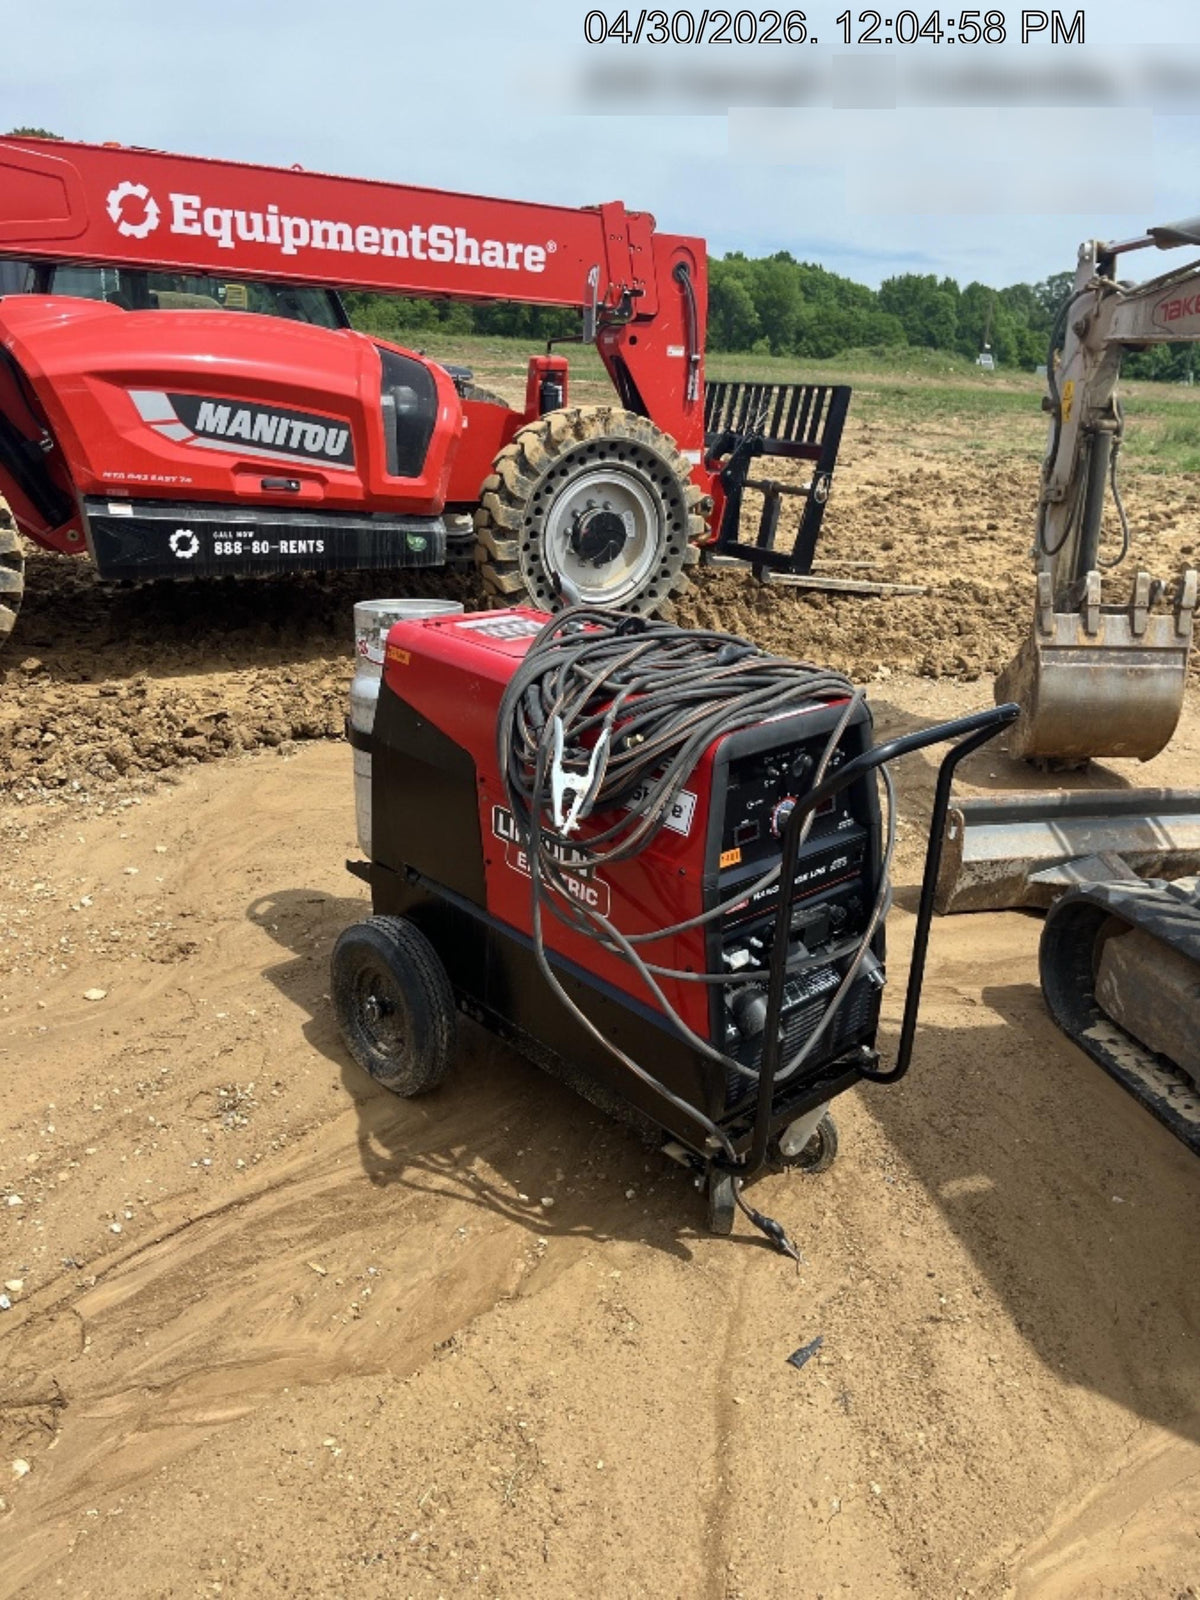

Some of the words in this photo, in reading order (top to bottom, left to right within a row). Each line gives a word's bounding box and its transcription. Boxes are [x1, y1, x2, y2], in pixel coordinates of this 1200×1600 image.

[195, 401, 350, 456] MANITOU
[213, 531, 231, 539] CALL
[214, 540, 325, 555] 888-80-RENTS
